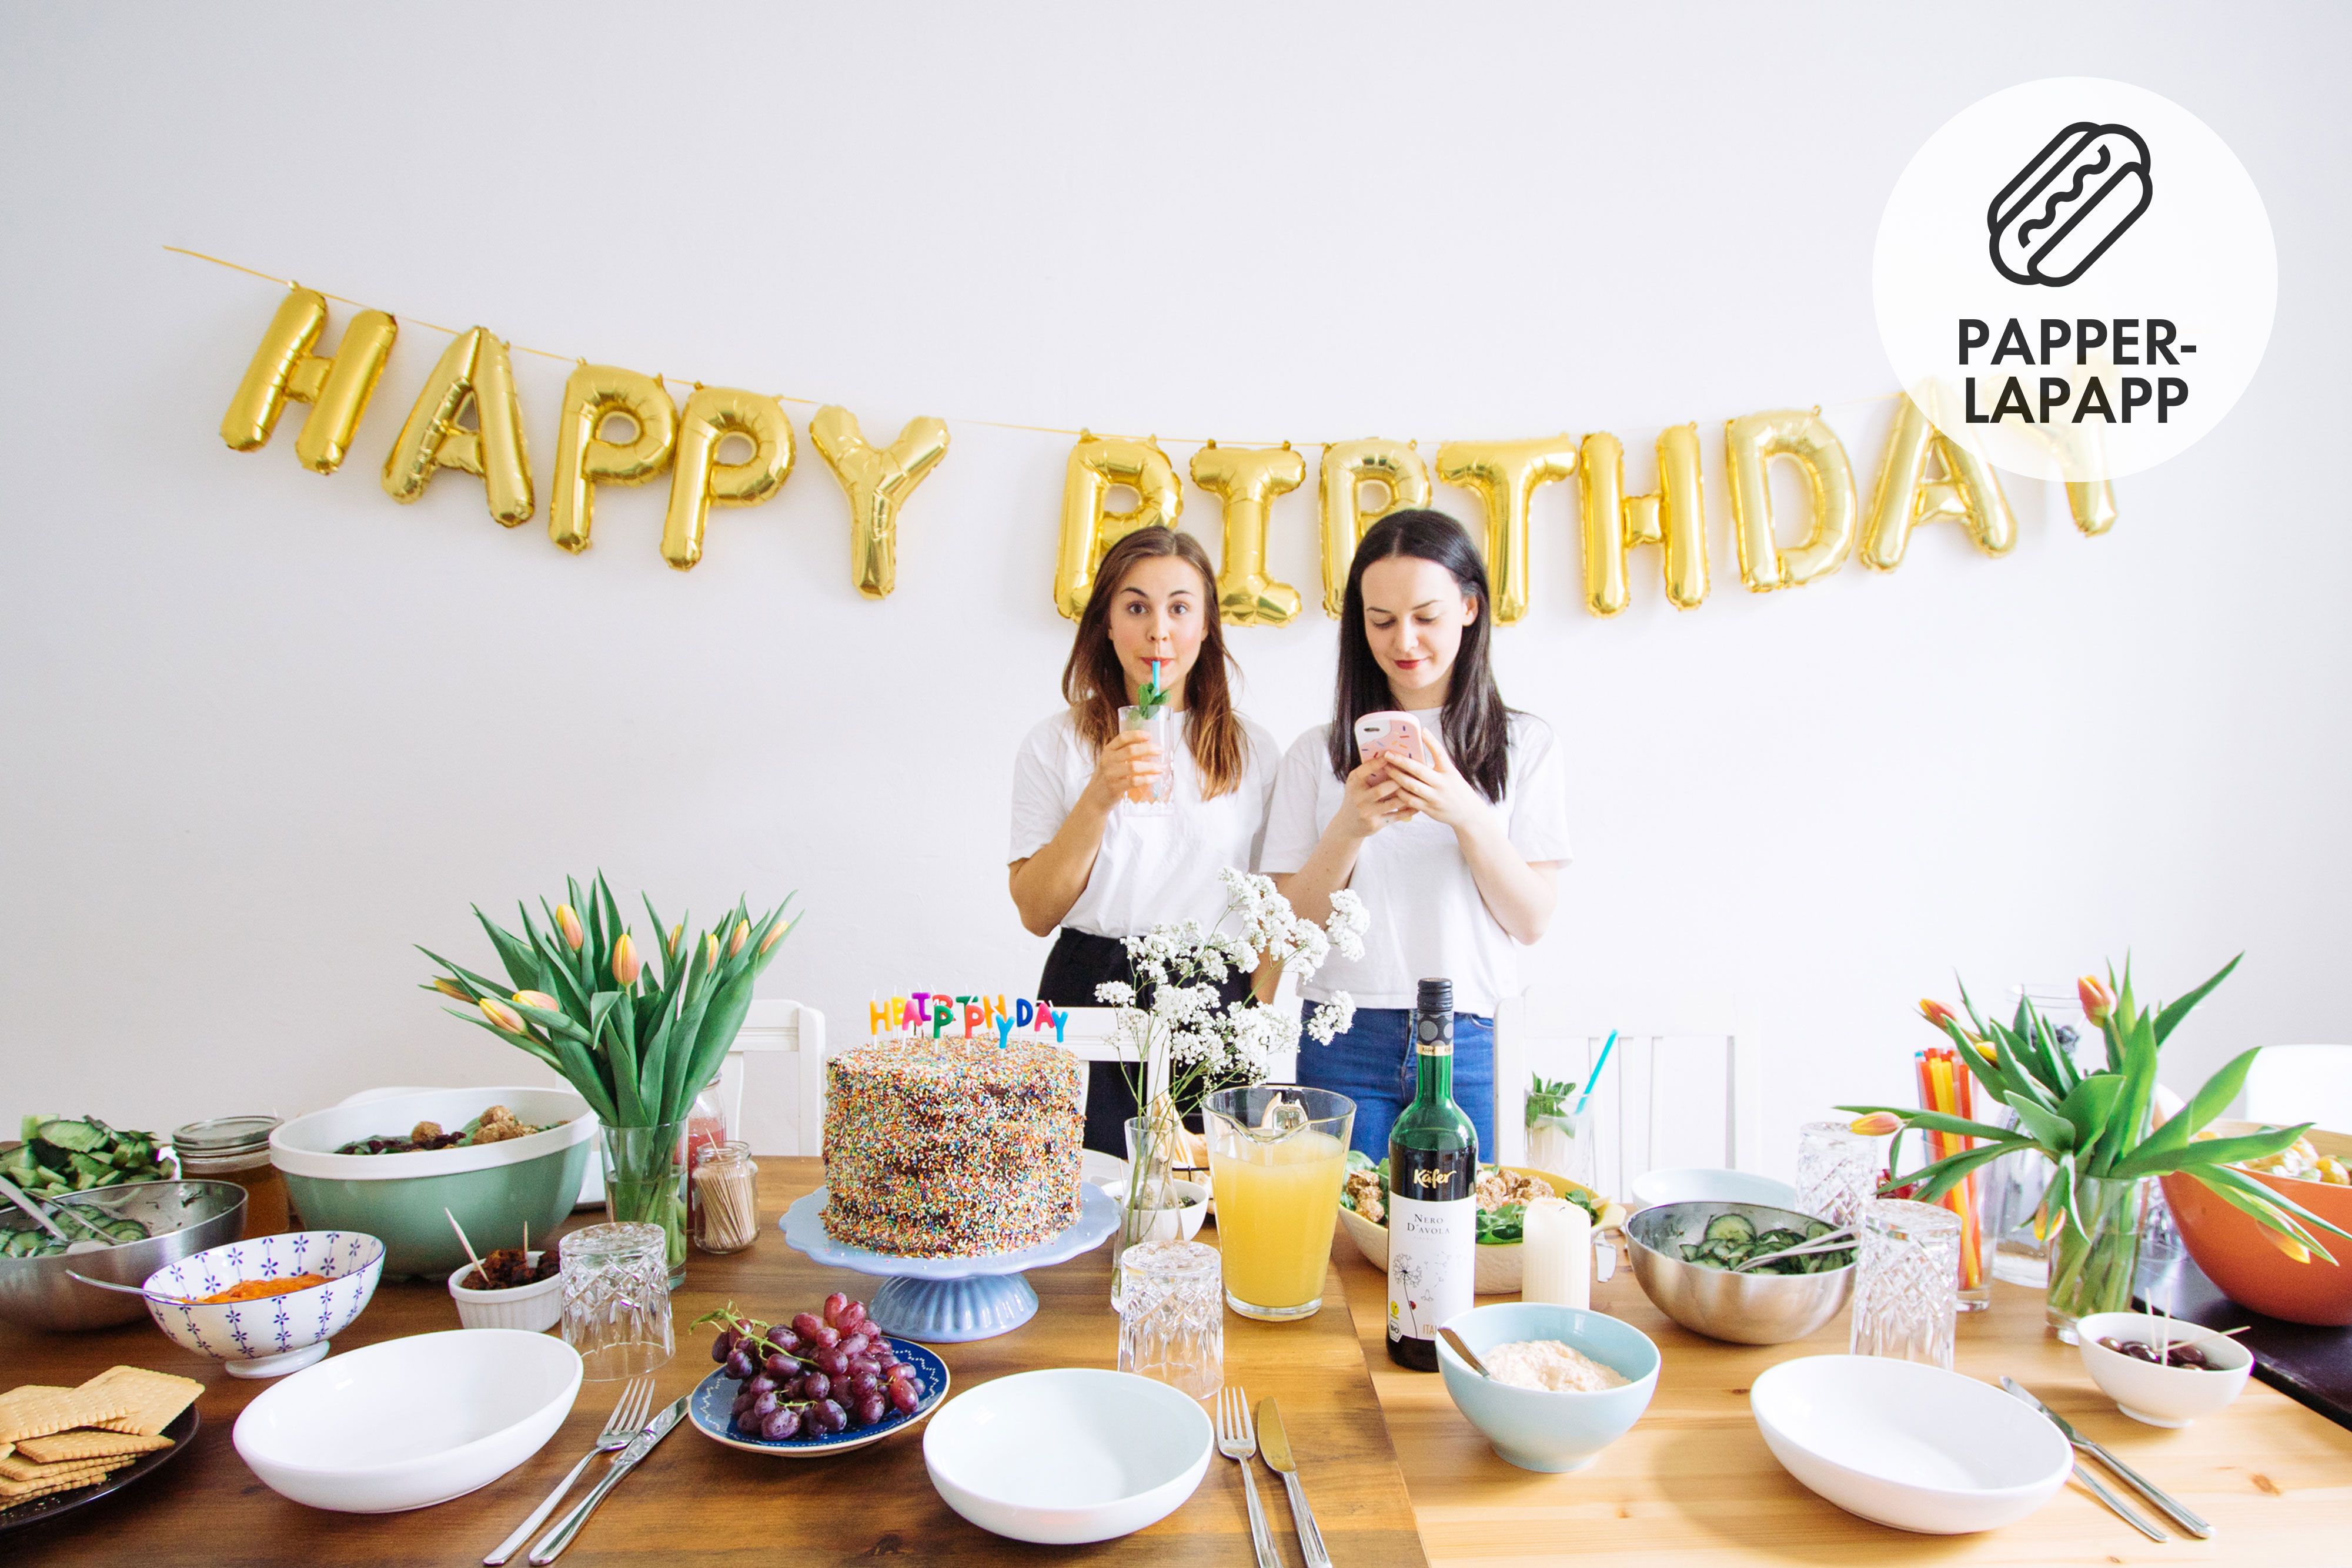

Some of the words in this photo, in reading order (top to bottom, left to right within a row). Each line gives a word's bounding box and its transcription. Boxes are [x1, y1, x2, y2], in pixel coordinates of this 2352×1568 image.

[220, 285, 951, 600] HAPPY
[1054, 354, 2119, 628] BIRTHDAY
[1414, 1168, 1457, 1189] Käfer
[1414, 1213, 1444, 1223] NERO
